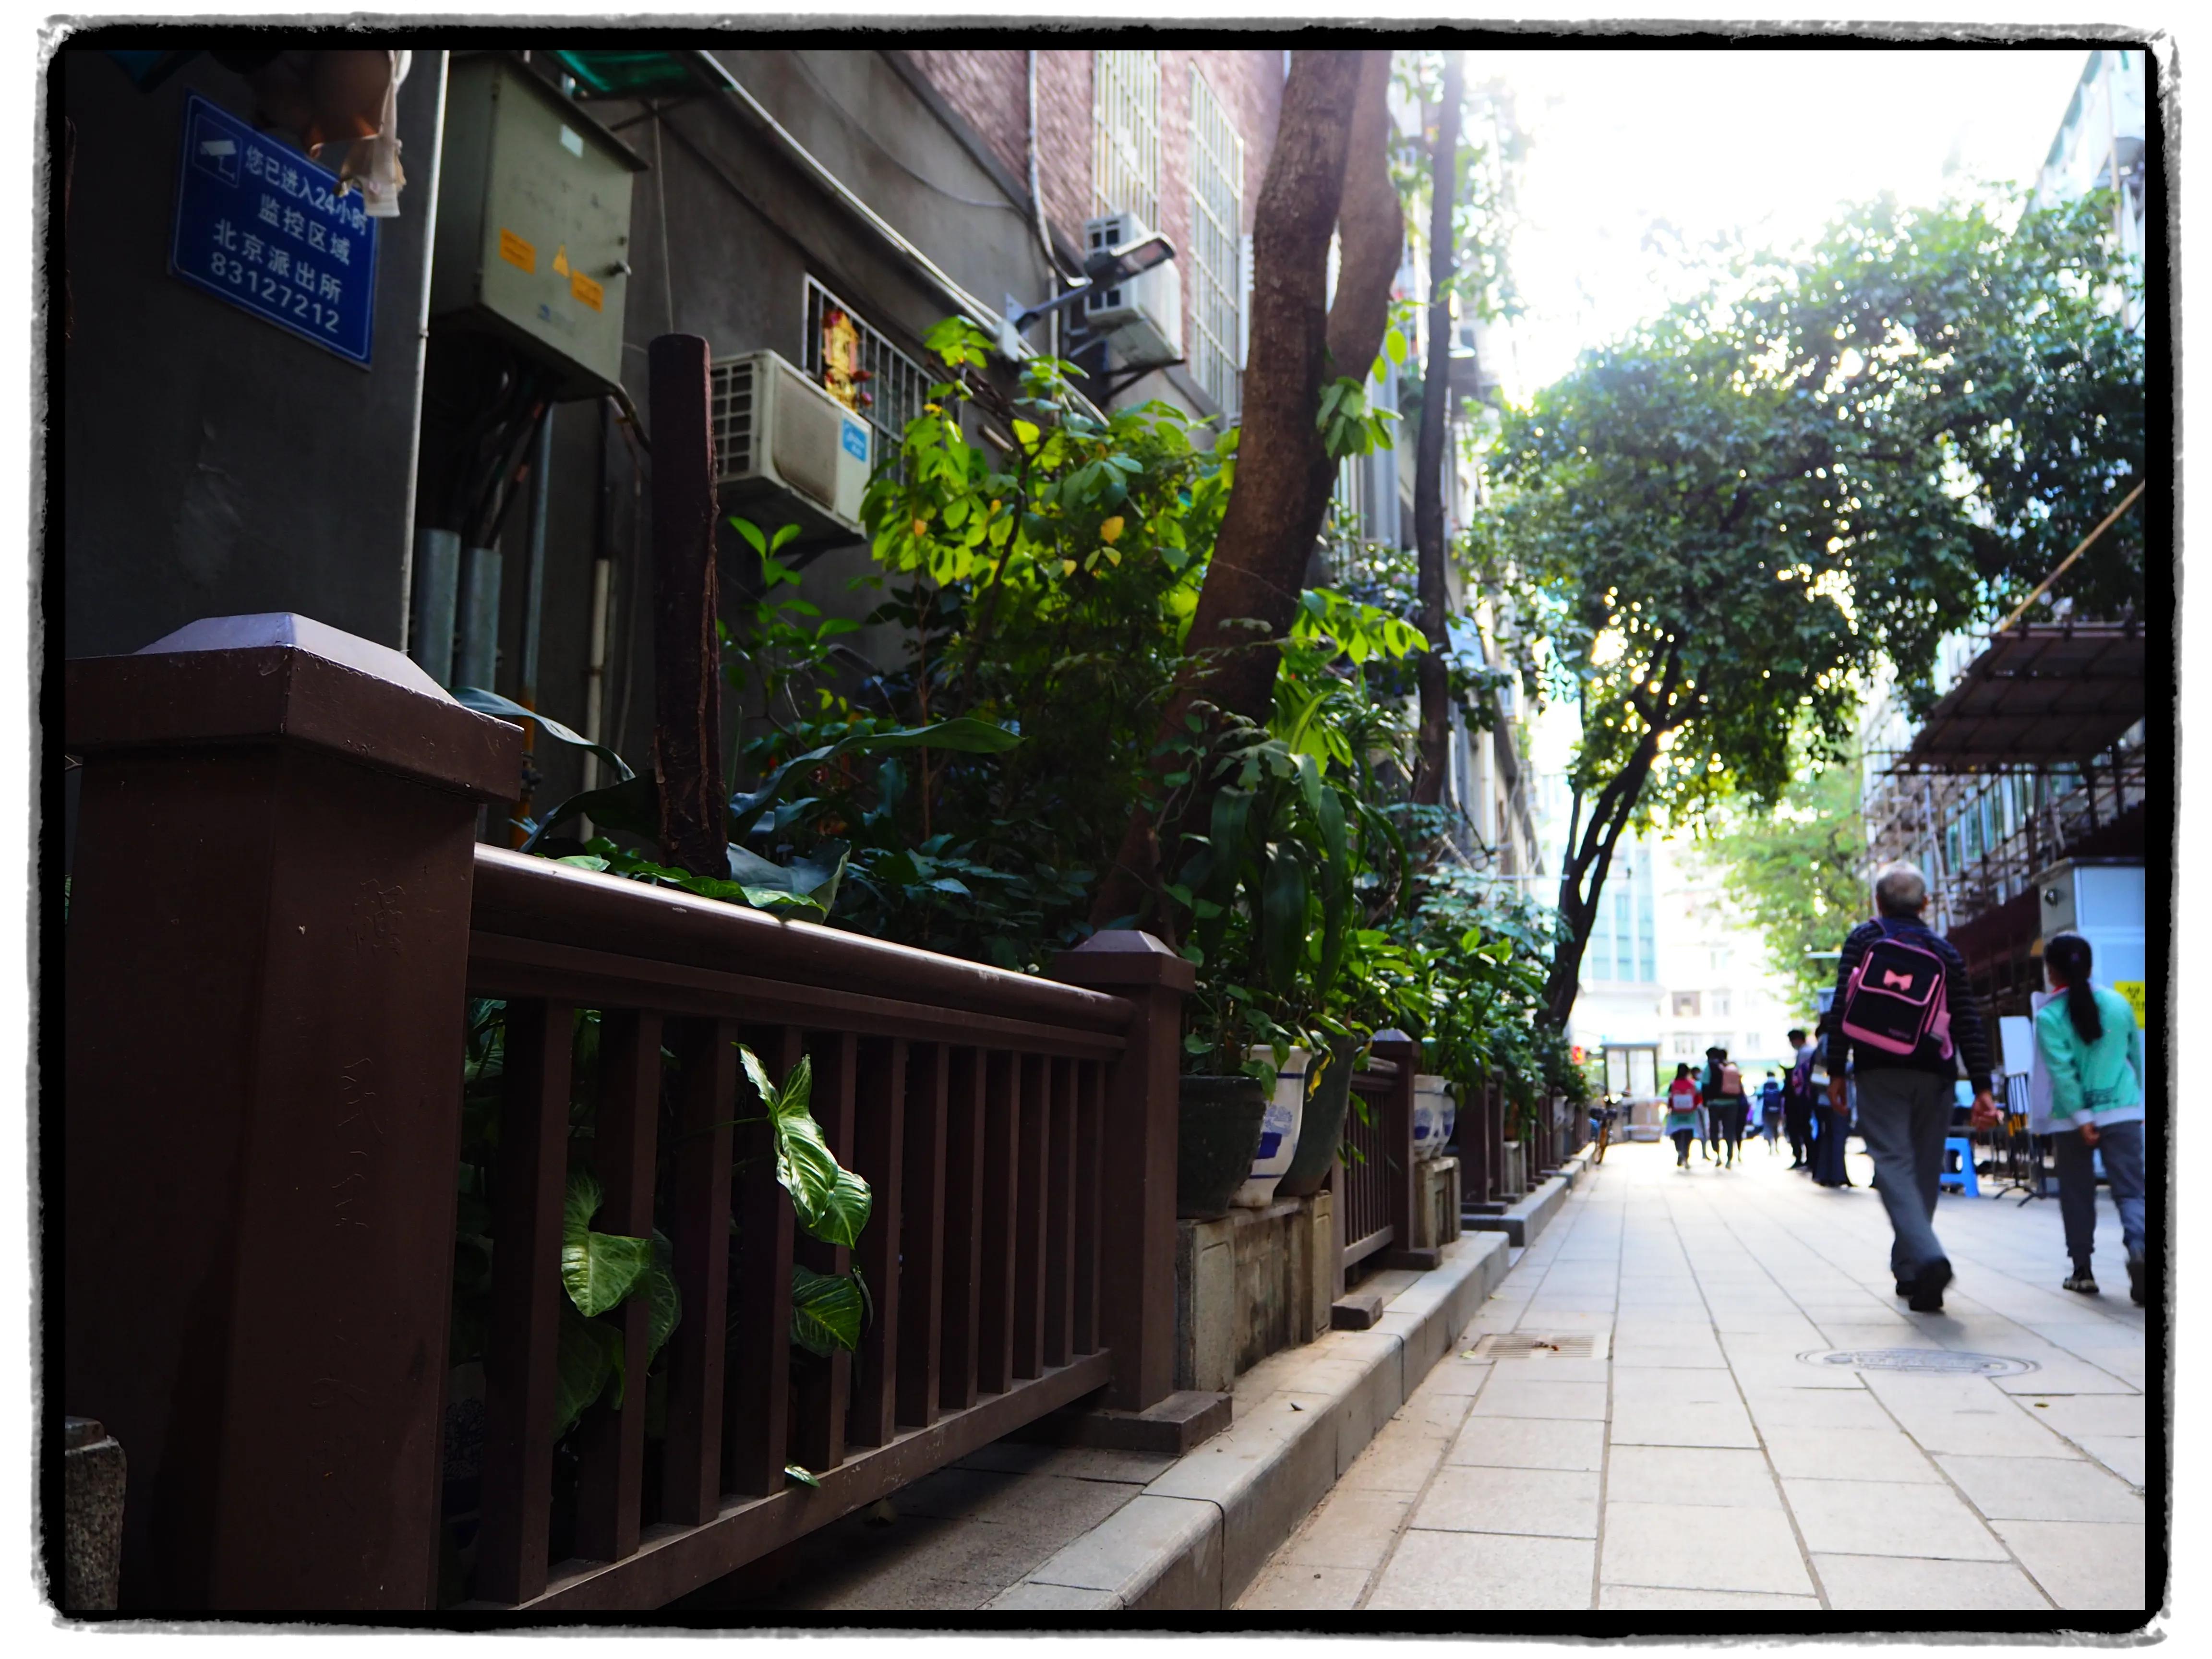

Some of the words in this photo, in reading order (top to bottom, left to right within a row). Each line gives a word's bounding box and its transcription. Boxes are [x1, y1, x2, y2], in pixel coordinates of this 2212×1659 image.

[245, 144, 368, 236] 您已进入24小时
[258, 193, 351, 265] 监控区域
[210, 252, 340, 333] 83127212
[213, 218, 341, 304] 北京派出所
